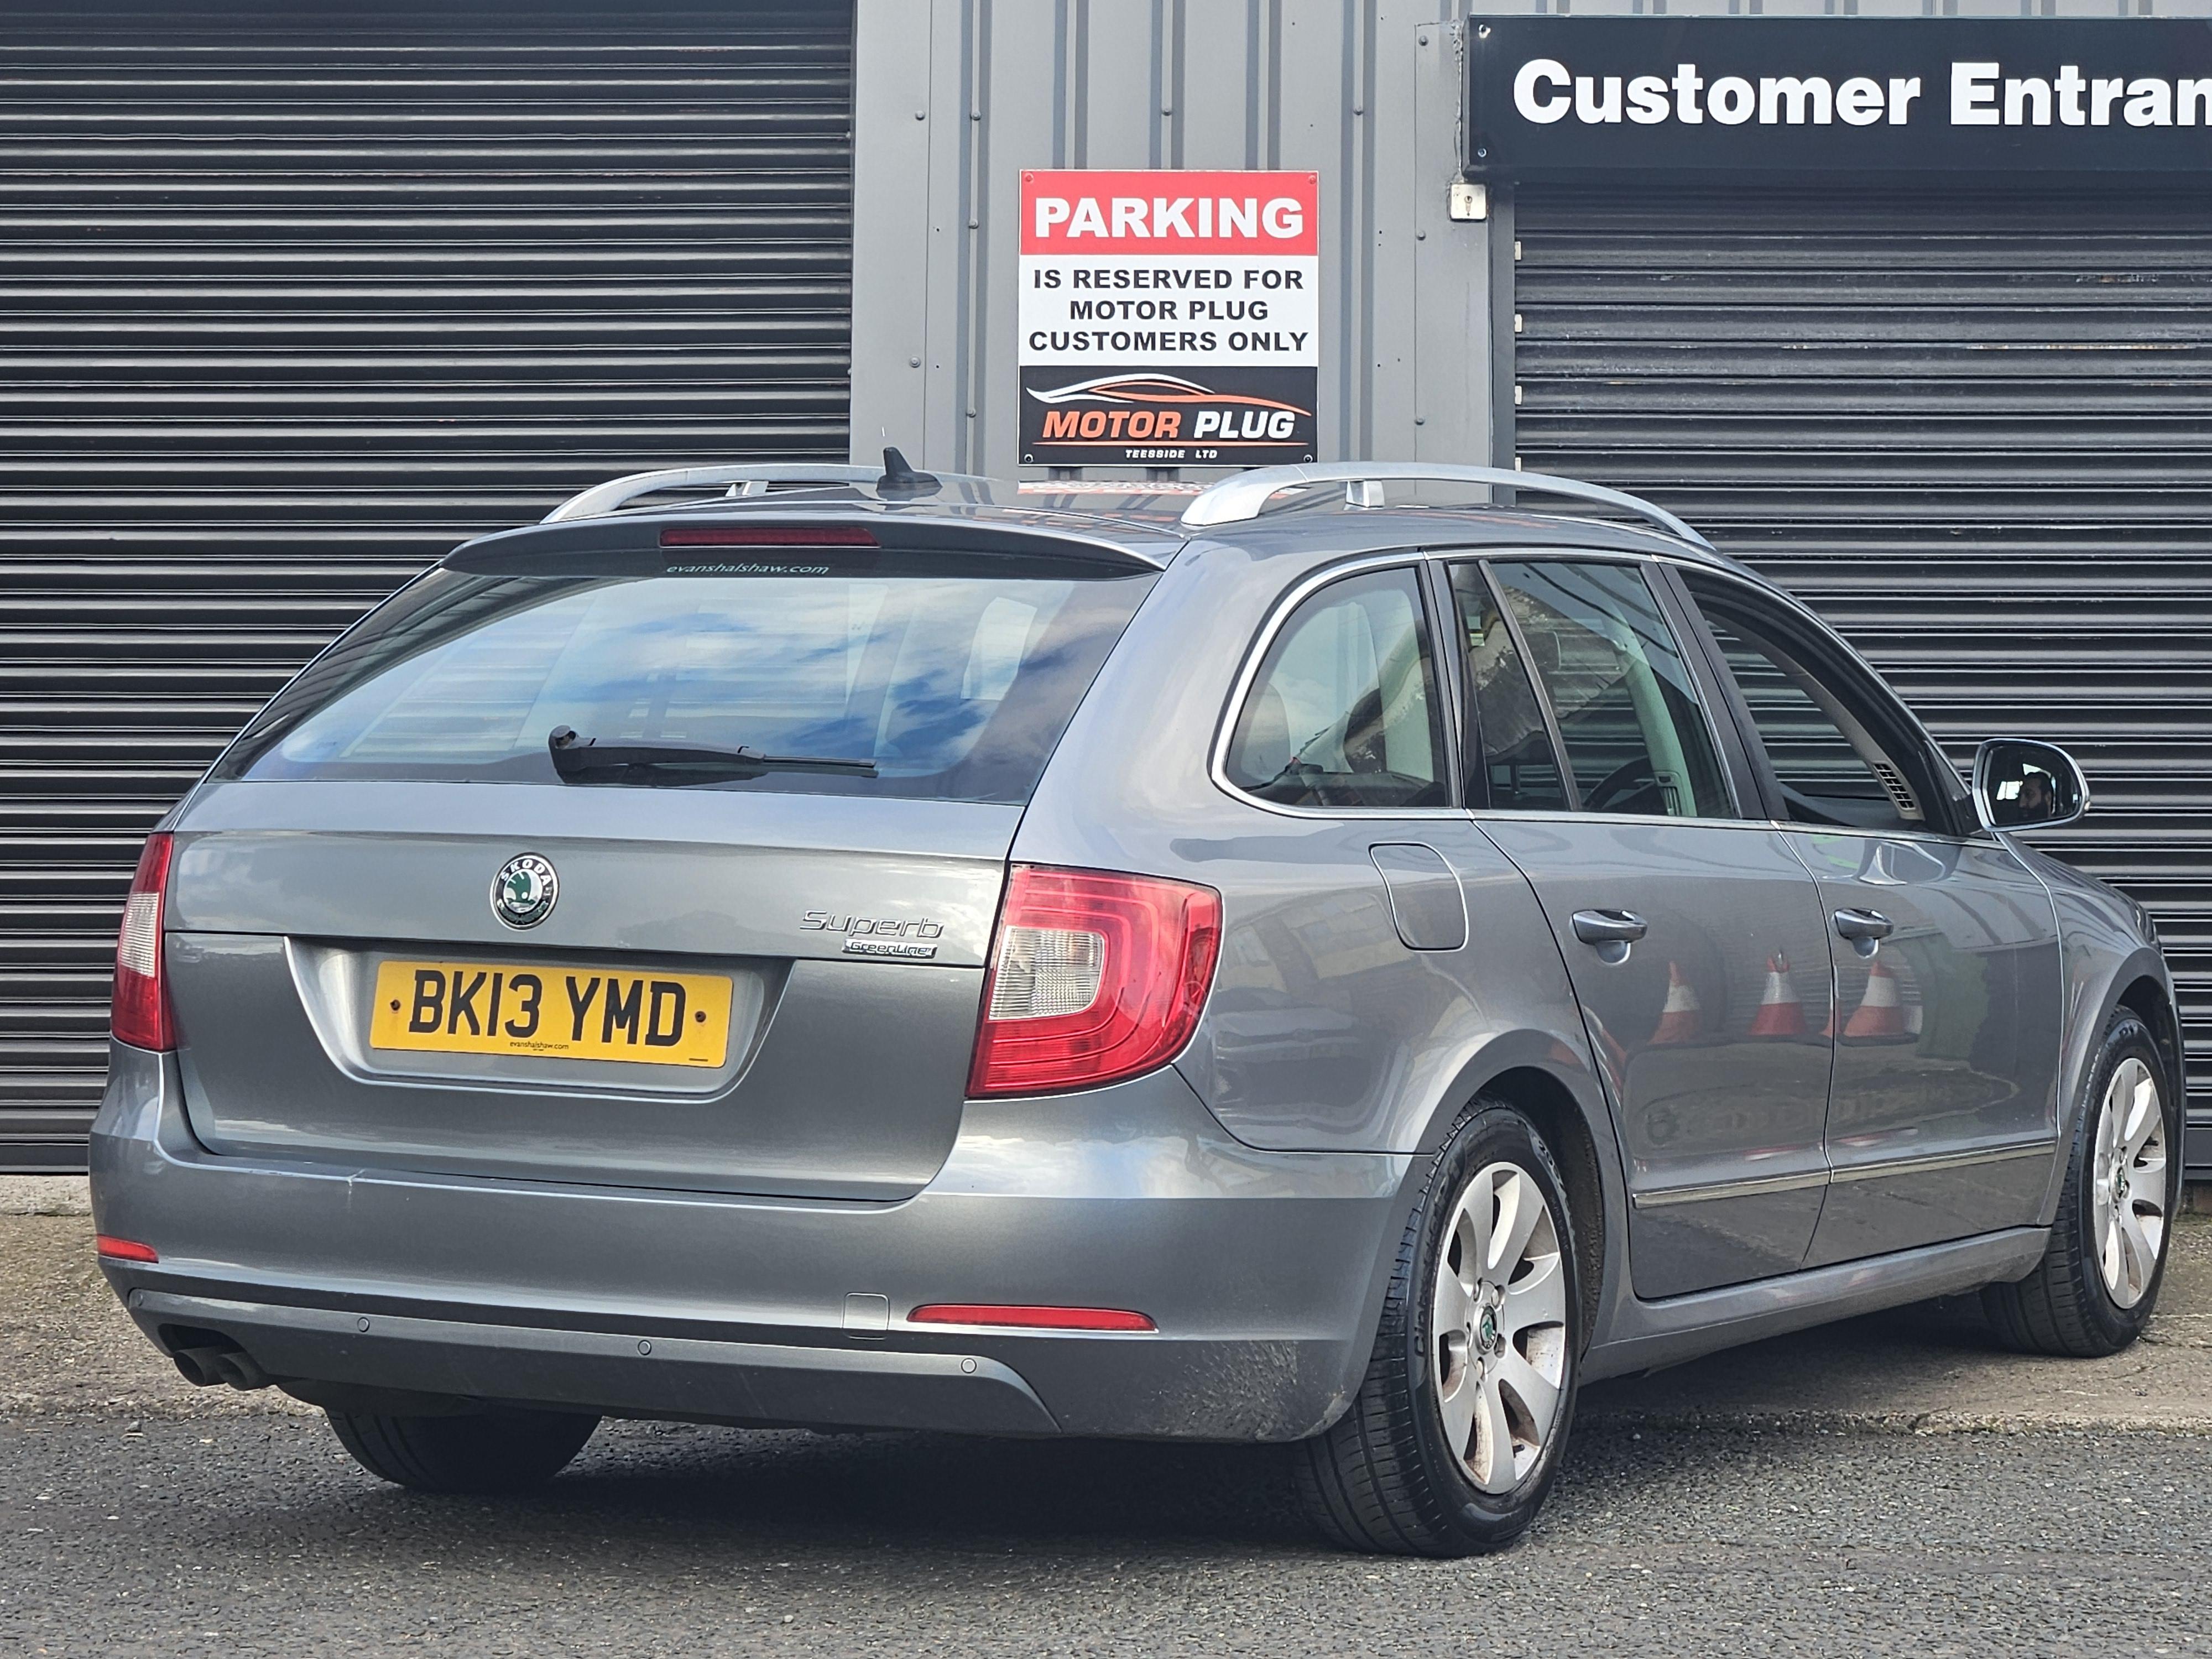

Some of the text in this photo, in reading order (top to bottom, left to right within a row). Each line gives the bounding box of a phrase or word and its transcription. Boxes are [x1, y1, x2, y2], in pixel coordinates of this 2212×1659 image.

[1514, 59, 2212, 127] Customer Entran
[1035, 197, 1303, 239] PARKING
[1034, 269, 1303, 289] IS RESERVED FOR
[1070, 300, 1269, 320] MOTOR PLUG
[1029, 331, 1308, 351] CUSTOMERS ONLY
[1042, 411, 1295, 439] MOTOR PLUG
[1125, 450, 1218, 459] TEESSIDE LTD
[666, 563, 829, 575] evanshalshaw.com
[800, 910, 945, 938] Superb
[409, 969, 687, 1047] BK13 YMD
[510, 1041, 569, 1050] evanshalshaw.com
